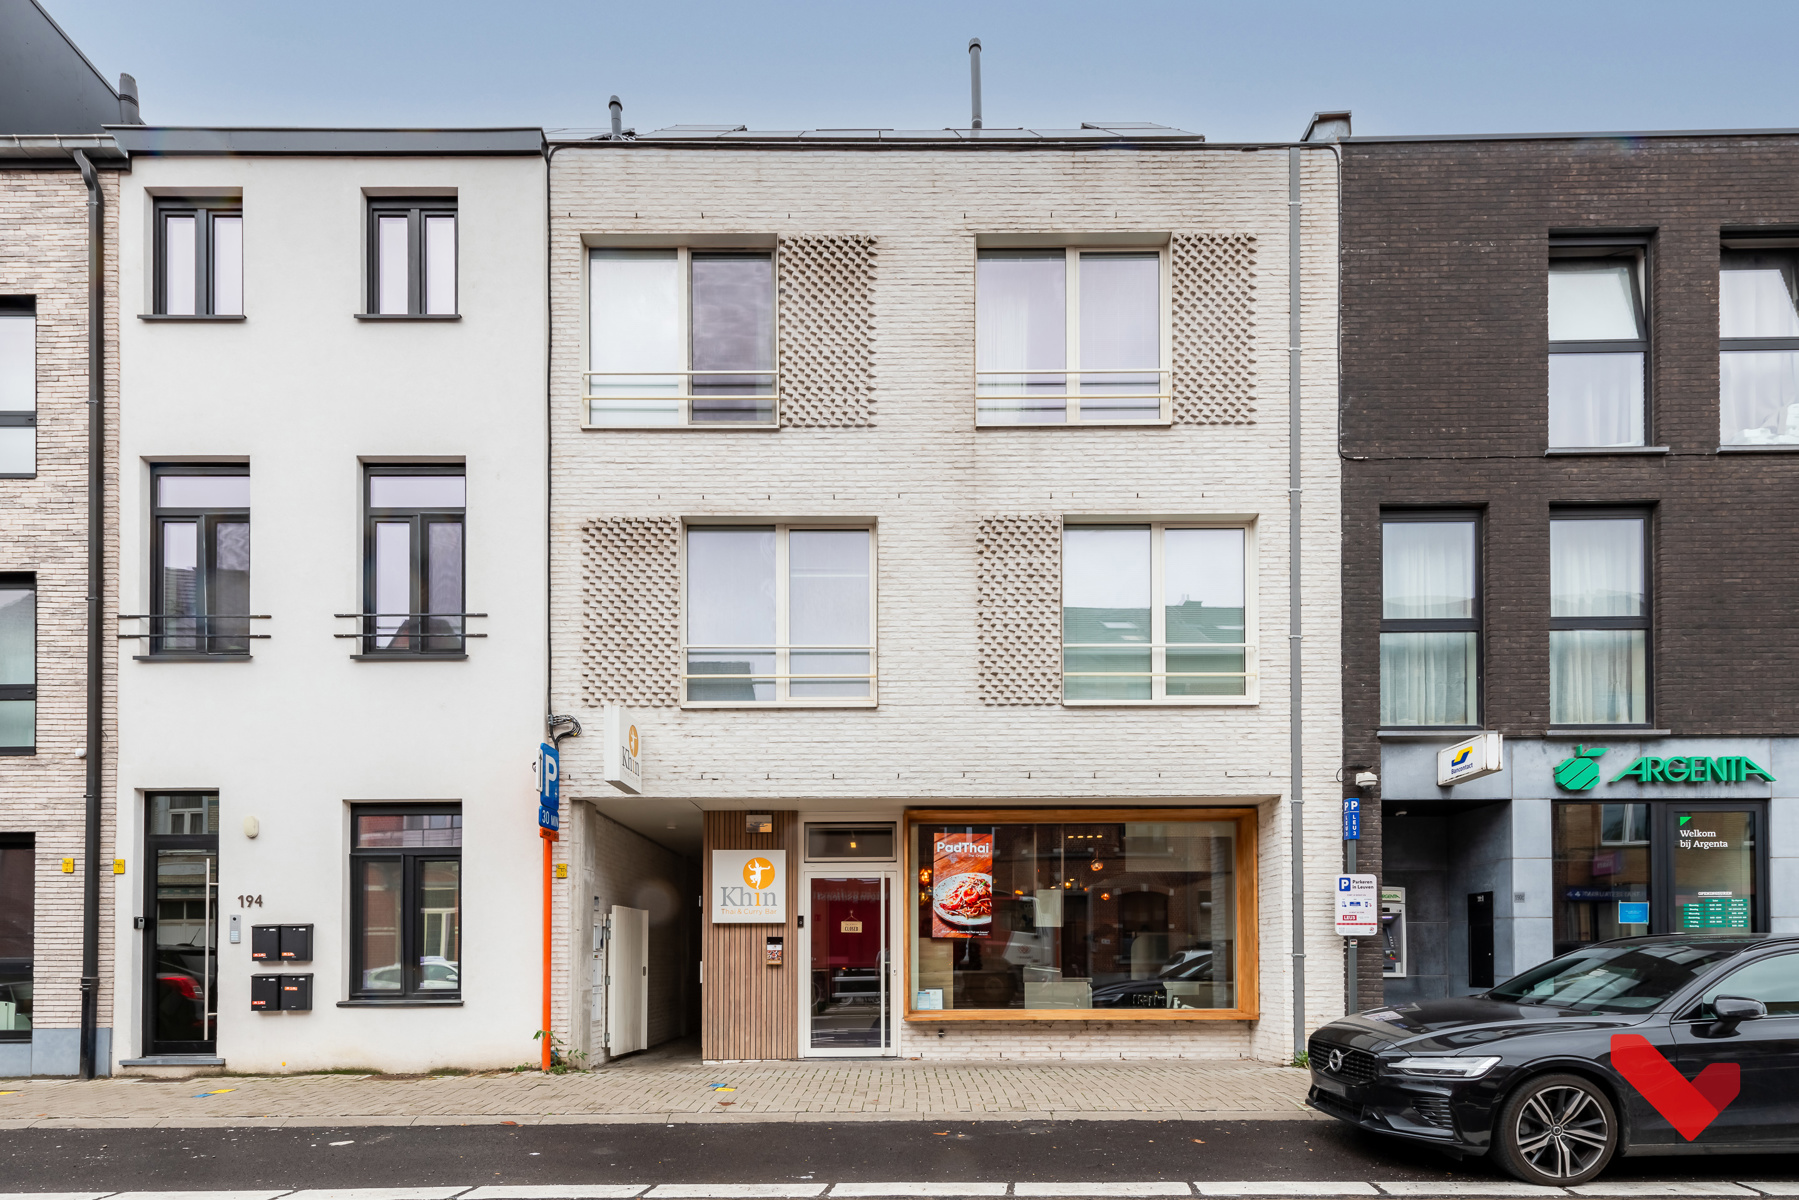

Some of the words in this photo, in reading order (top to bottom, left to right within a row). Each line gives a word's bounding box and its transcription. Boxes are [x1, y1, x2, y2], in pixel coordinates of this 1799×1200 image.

[622, 746, 640, 776] Khin
[1451, 762, 1474, 775] Bancontact
[1607, 755, 1778, 784] ARGENTA
[545, 753, 558, 798] P
[1344, 801, 1349, 811] P
[1350, 800, 1359, 811] P
[541, 809, 550, 825] 30
[551, 815, 559, 828] MIN
[1679, 829, 1717, 838] Welkom
[936, 841, 990, 854] PadThai
[1679, 839, 1692, 849] bij
[1693, 840, 1729, 849] Argenta
[1341, 879, 1349, 890] P
[237, 894, 264, 908] 194
[720, 886, 778, 907] Khin
[743, 908, 763, 916] Curry
